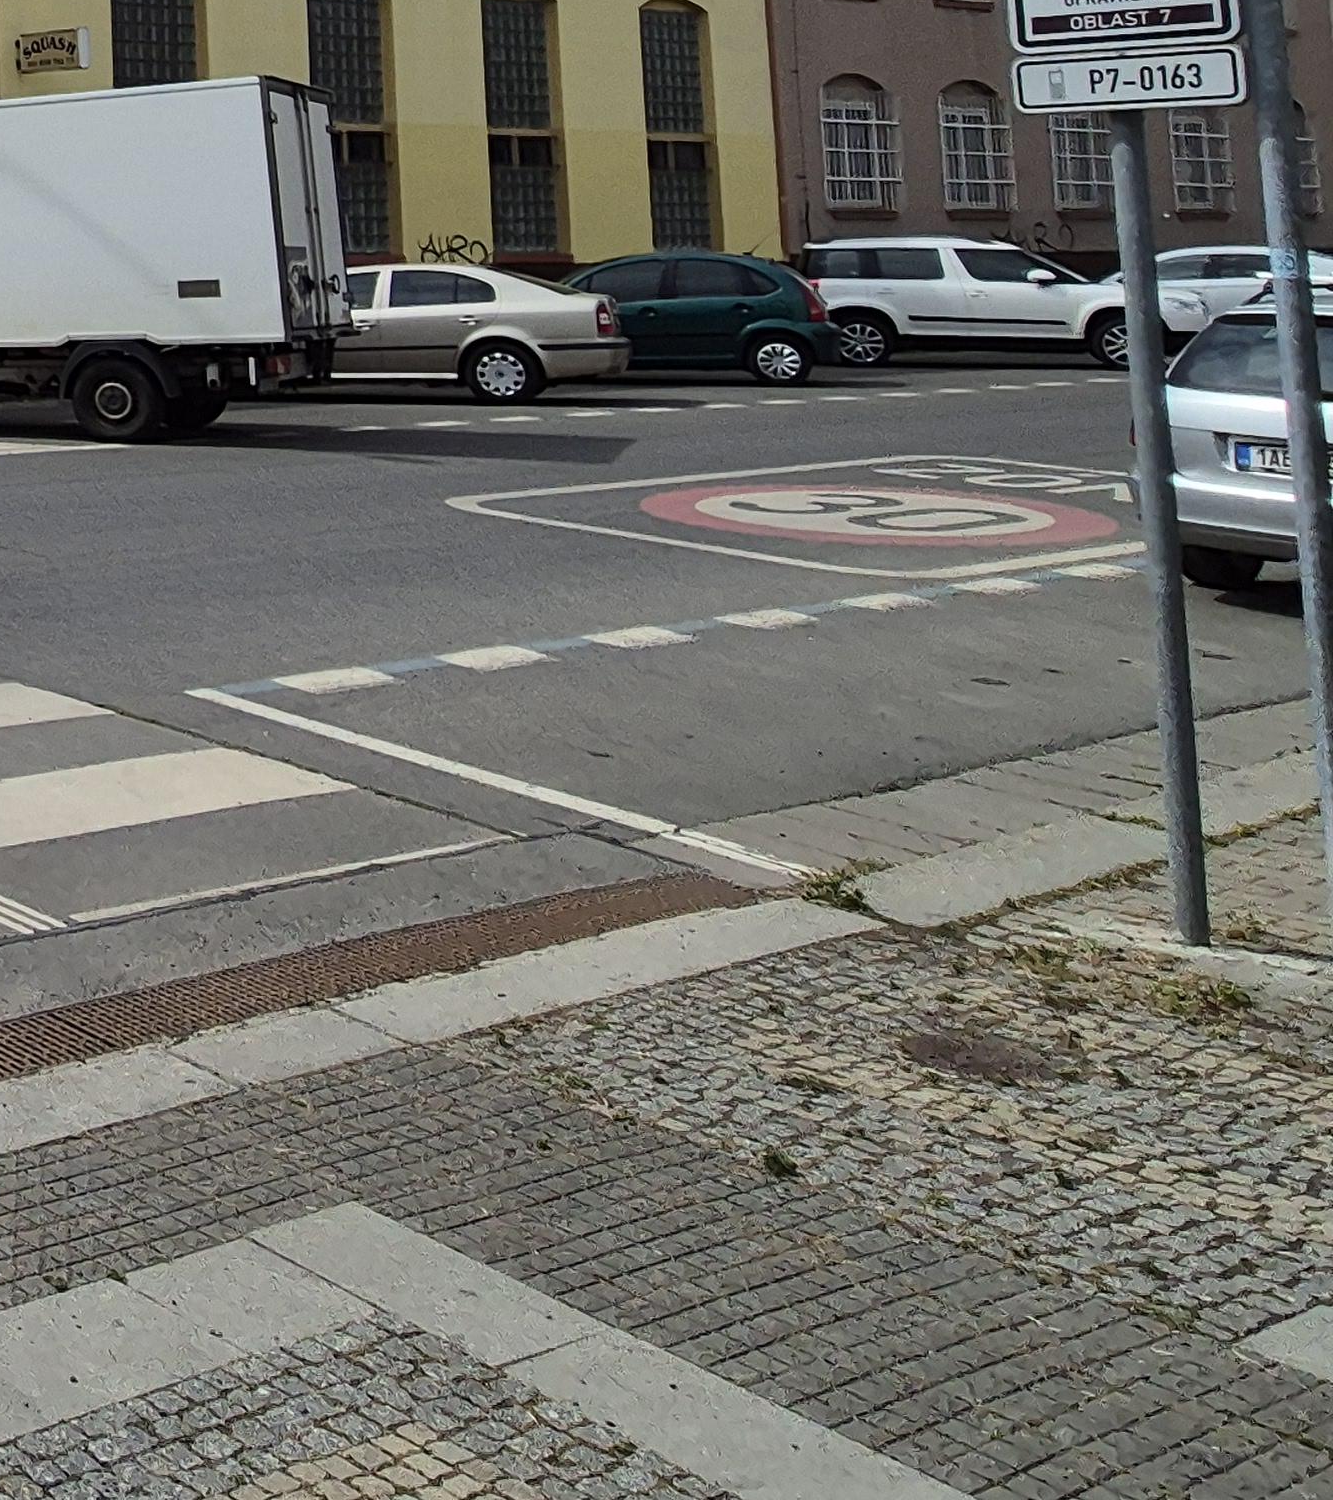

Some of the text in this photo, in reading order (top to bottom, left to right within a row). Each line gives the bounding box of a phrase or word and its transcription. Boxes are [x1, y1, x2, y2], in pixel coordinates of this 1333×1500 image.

[1070, 9, 1172, 31] OBLAST 7
[22, 36, 77, 60] SQUASH
[1088, 63, 1203, 94] P7-0163
[729, 493, 1028, 532] 30
